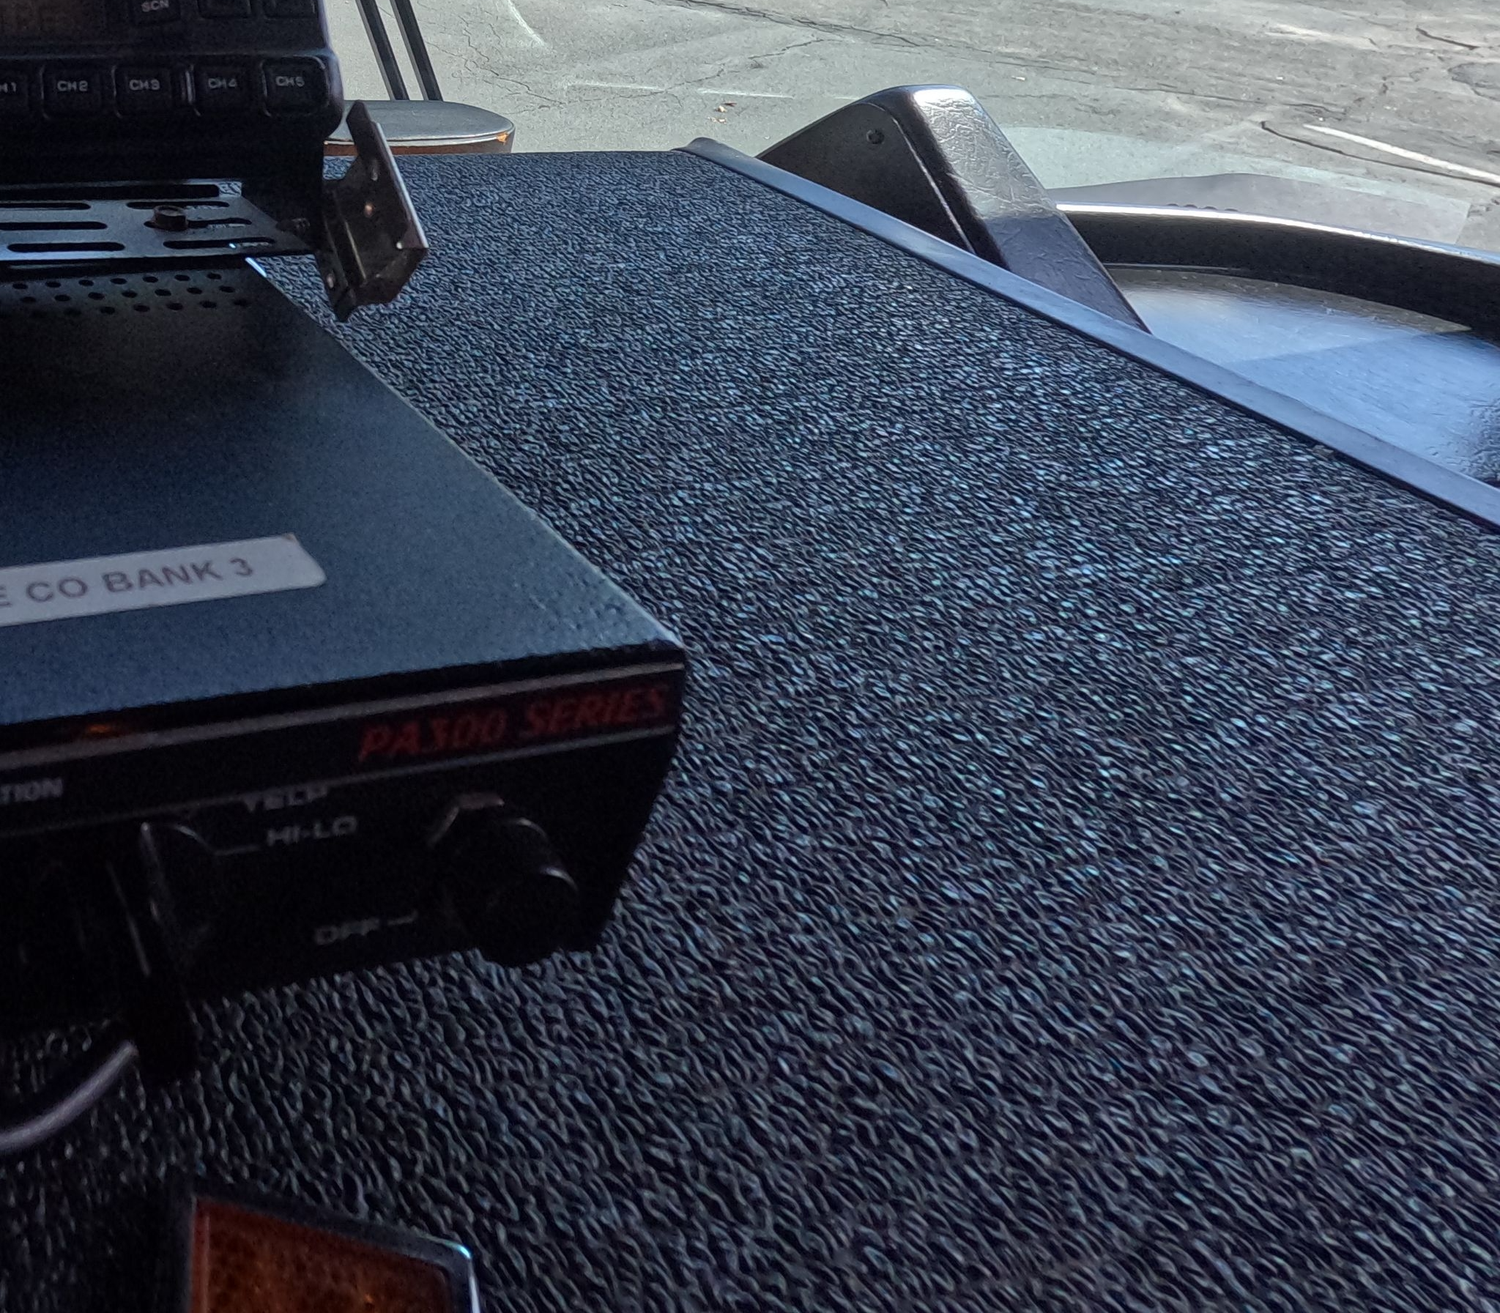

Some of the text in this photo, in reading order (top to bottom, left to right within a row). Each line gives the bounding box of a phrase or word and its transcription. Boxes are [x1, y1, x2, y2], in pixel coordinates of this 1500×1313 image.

[56, 79, 89, 92] CH2
[129, 78, 161, 91] CH3
[275, 74, 306, 88] CH5
[25, 577, 89, 603] CO
[102, 560, 222, 594] BANK
[230, 557, 255, 577] 3
[517, 682, 670, 740] SERIES
